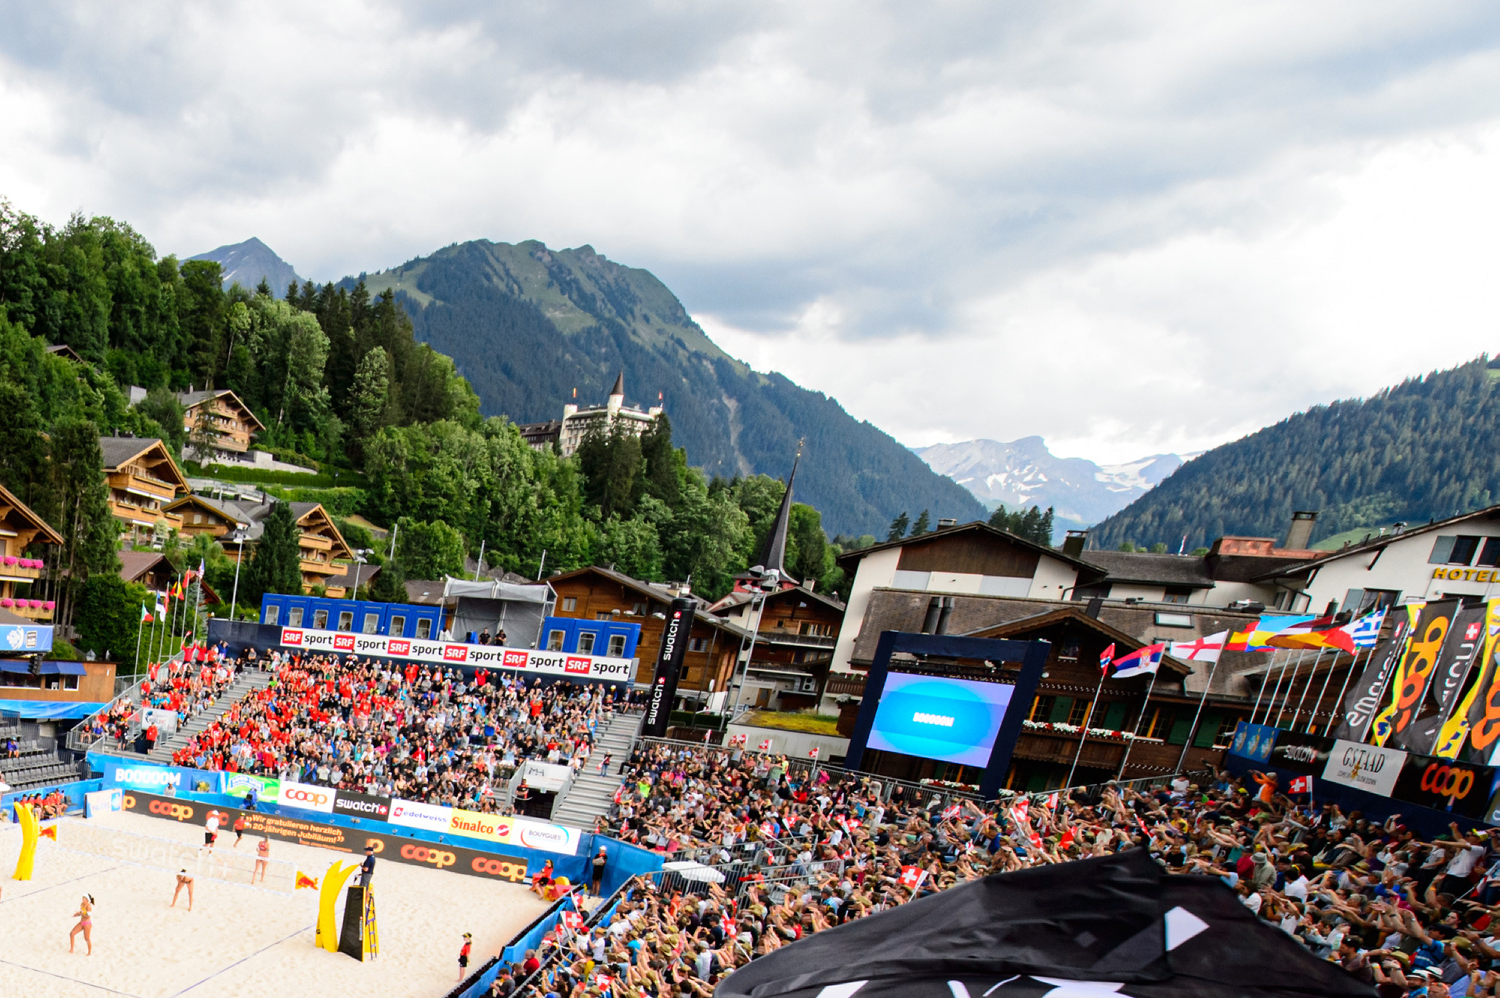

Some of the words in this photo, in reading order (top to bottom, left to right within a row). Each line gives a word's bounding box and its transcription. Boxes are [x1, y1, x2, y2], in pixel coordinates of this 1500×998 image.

[1432, 567, 1500, 583] HOTEL
[663, 618, 680, 661] swatch
[284, 632, 301, 642] SRF
[304, 633, 333, 645] sport
[336, 637, 353, 647] SRF
[357, 639, 387, 651] sport
[389, 642, 408, 653] SRF
[411, 644, 443, 656] sport
[445, 648, 466, 659] SRF
[469, 650, 502, 662] sport
[505, 654, 526, 665] SRF
[529, 656, 564, 669] sport
[567, 660, 589, 671] SRF
[593, 661, 629, 675] sport
[648, 684, 665, 725] swatch
[1342, 747, 1386, 773] GSTAAD
[115, 768, 182, 785] BOOOOOM
[1420, 763, 1475, 801] coop
[285, 788, 327, 806] coop
[336, 798, 379, 814] swatch
[148, 800, 194, 821] coop
[403, 810, 447, 824] edelweiss
[252, 824, 297, 837] 20-jährigen
[266, 817, 309, 830] gratulieren
[309, 824, 342, 836] herzlich
[451, 816, 494, 835] Sinalco
[528, 829, 562, 841] BOUYGUES
[400, 844, 457, 868] coop
[471, 856, 527, 882] coop
